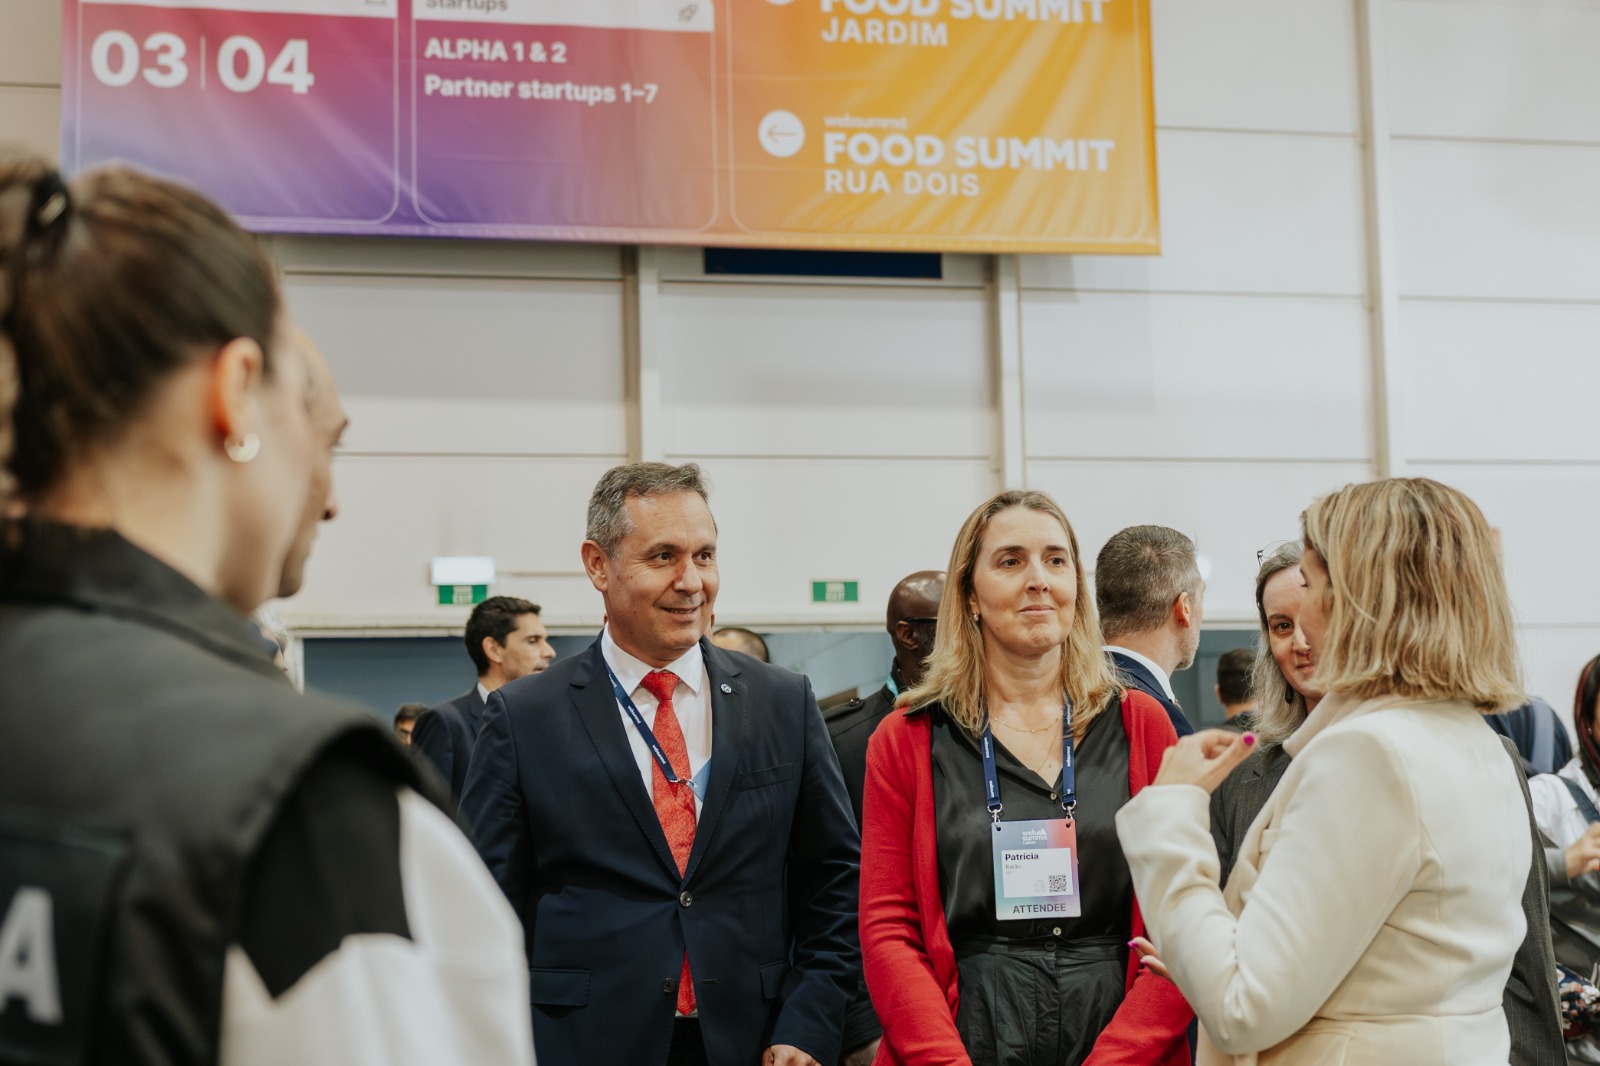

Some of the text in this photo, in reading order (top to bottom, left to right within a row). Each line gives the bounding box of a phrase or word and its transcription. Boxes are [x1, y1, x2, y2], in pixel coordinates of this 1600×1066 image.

[821, 18, 949, 47] JARDIM
[91, 30, 314, 94] 03 04
[424, 37, 568, 64] ALPHA 1 & 2
[424, 74, 515, 99] Partner
[518, 78, 617, 106] startups
[824, 132, 1115, 172] FOOD SUMMIT
[824, 169, 980, 197] RUA DOIS
[1013, 902, 1067, 914] ATTENDEE
